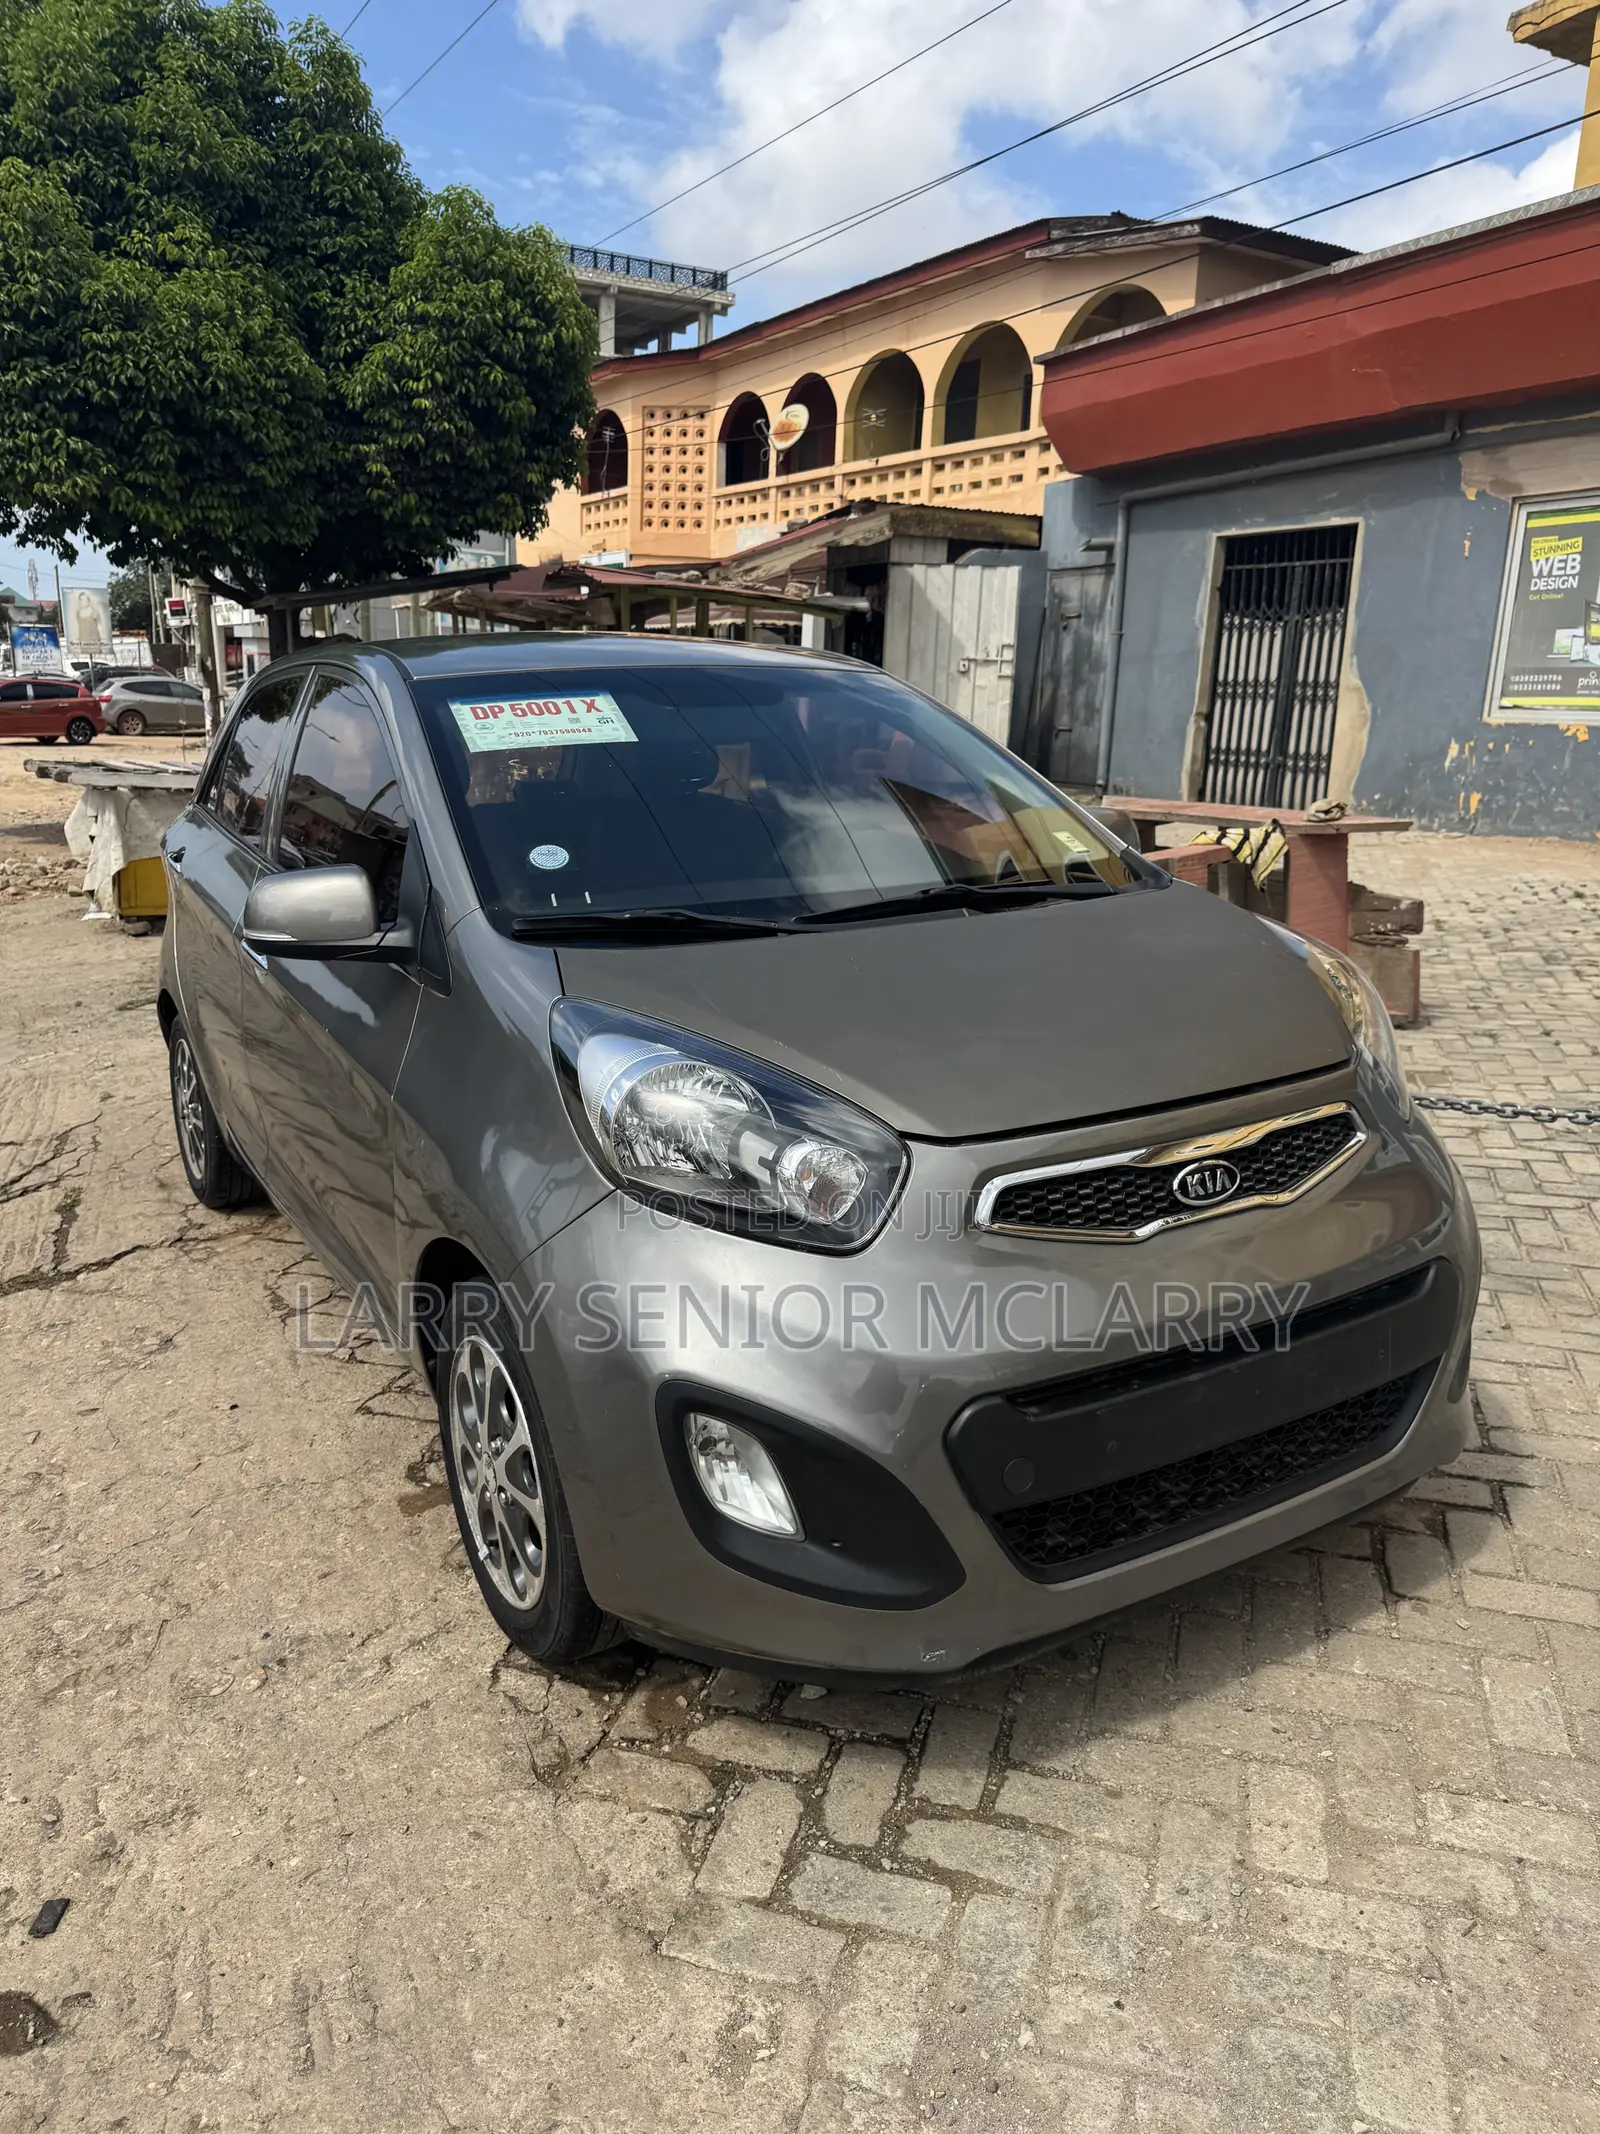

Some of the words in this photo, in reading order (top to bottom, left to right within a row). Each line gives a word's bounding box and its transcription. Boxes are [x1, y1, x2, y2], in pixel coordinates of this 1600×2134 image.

[1533, 540, 1580, 558] STUNNING
[1531, 553, 1581, 577] WEB
[1530, 575, 1579, 591] DESIGN
[469, 705, 505, 720] DP
[508, 700, 577, 718] 5001
[579, 698, 603, 713] X
